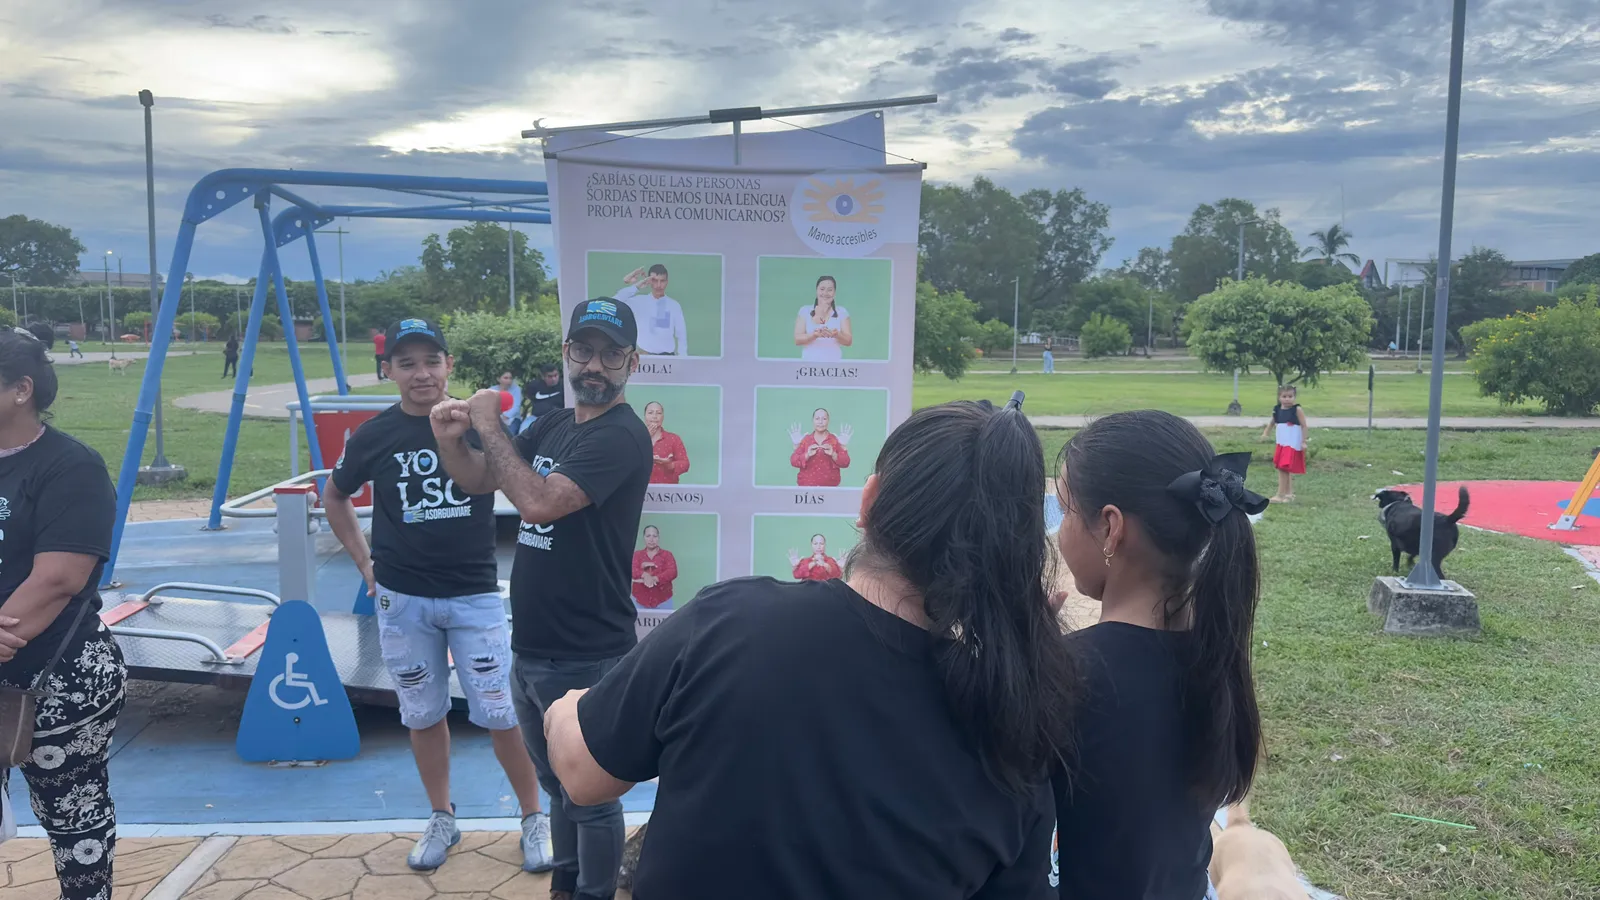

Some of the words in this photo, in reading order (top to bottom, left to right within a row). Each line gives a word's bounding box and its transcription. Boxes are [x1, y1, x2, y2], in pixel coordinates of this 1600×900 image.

[586, 171, 635, 188] ¿SABÍAS
[638, 174, 666, 189] QUE
[670, 175, 693, 188] LAS
[696, 176, 761, 190] PERSONAS
[586, 188, 637, 202] SORDAS
[640, 189, 702, 204] TENEMOS
[705, 192, 732, 205] UNA
[735, 193, 787, 207] LENGUA
[587, 204, 633, 218] PROPIA
[640, 206, 671, 219] PARA
[674, 207, 786, 222] COMUNICARNOS?
[807, 226, 835, 245] Manos
[835, 229, 878, 246] accesibles
[796, 367, 858, 380] ¡GRACIAS!
[393, 449, 438, 477] YO
[645, 492, 704, 505] NAS(NOS)
[794, 491, 825, 504] DÍAS
[424, 505, 472, 521] ASORGUAVIARE
